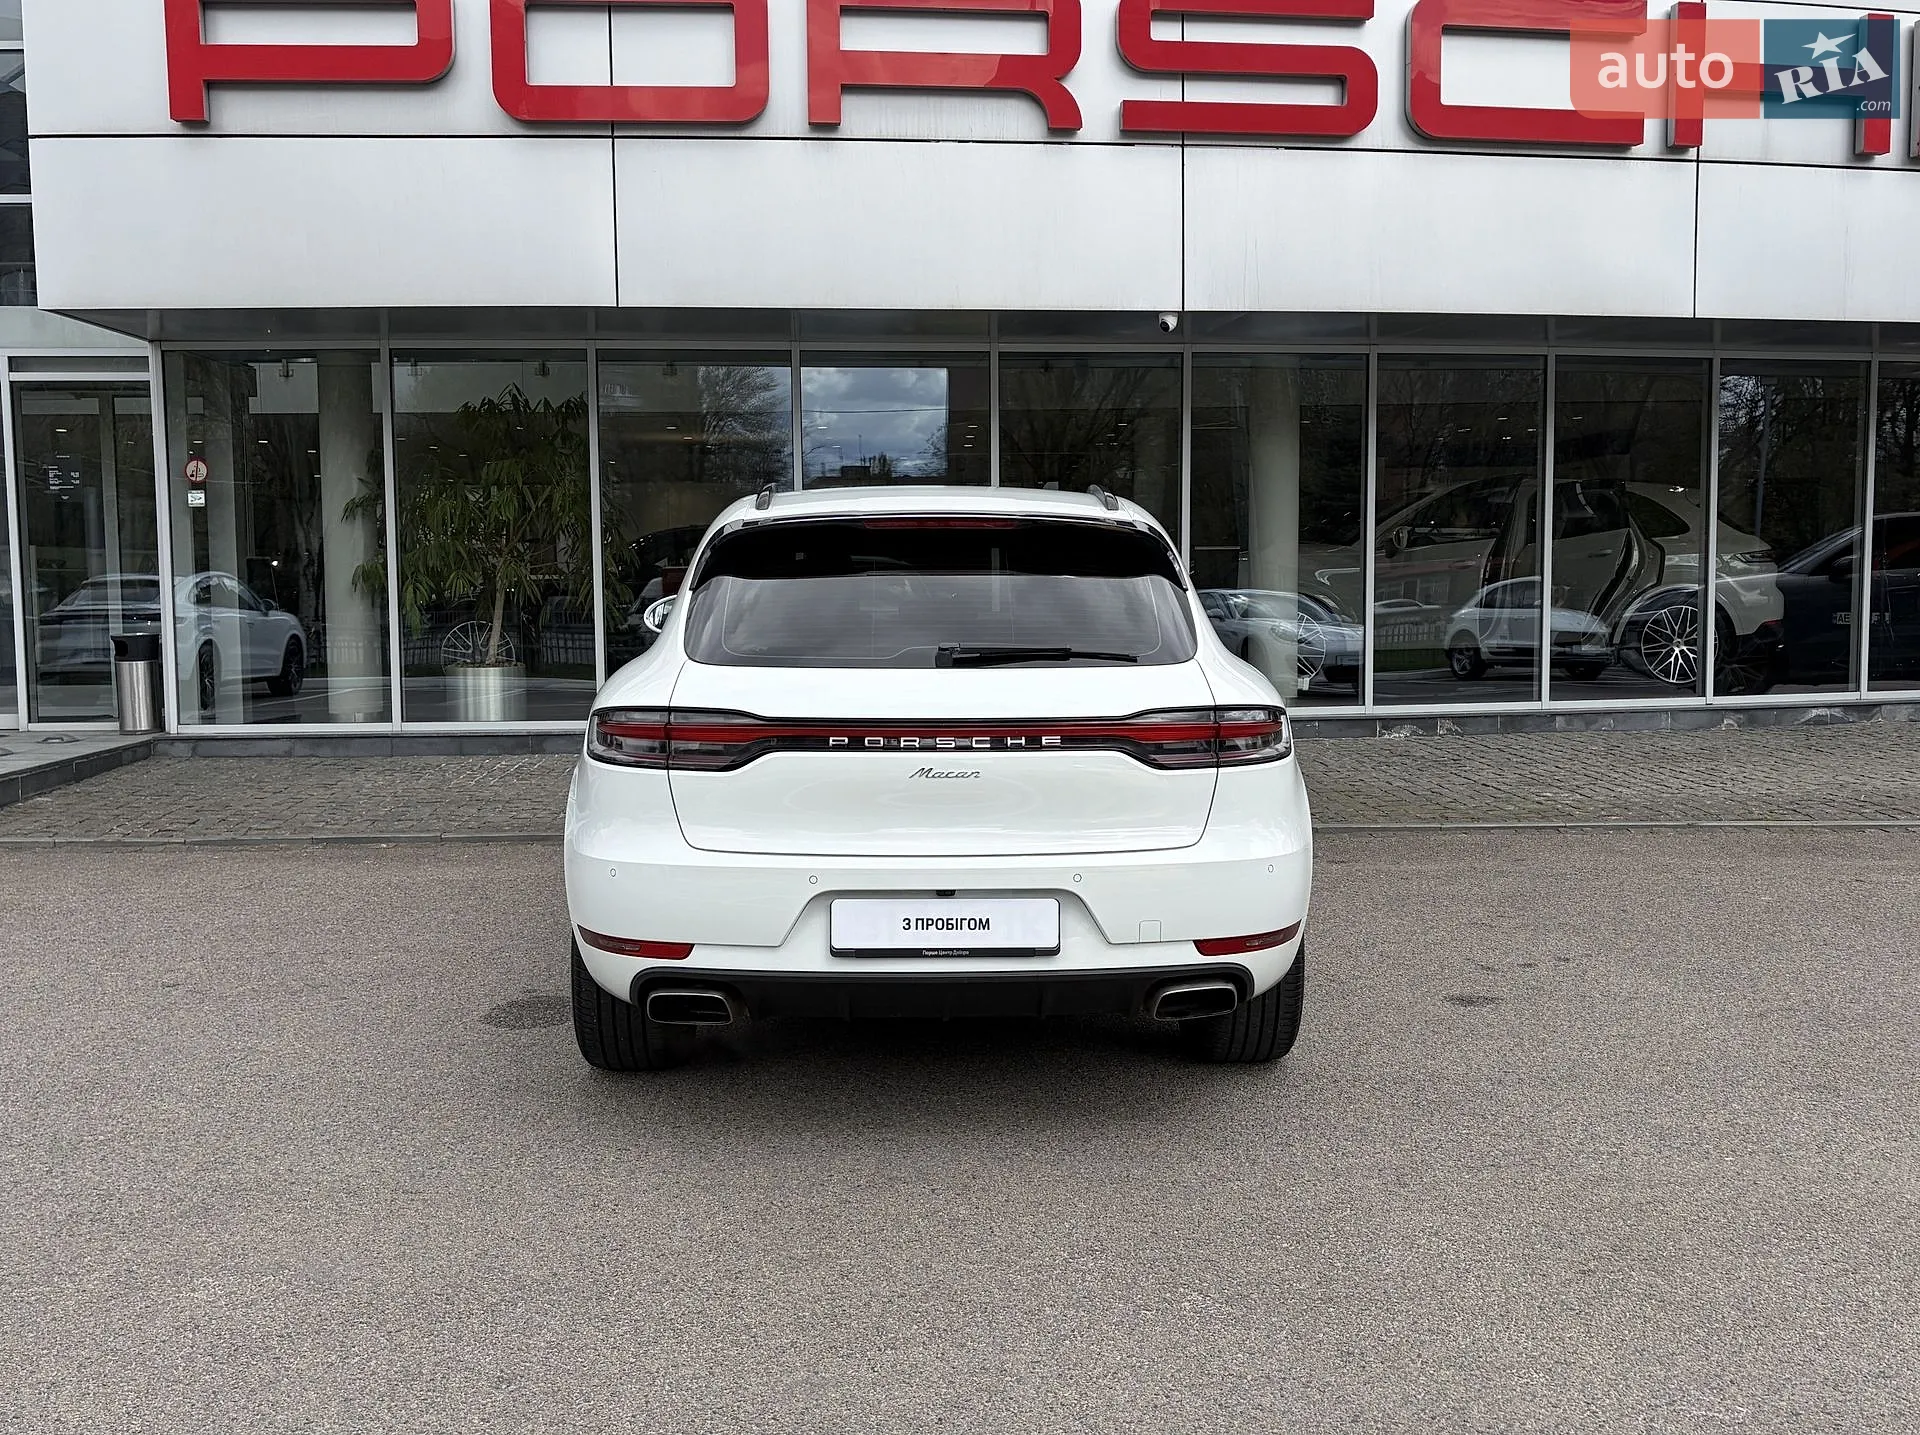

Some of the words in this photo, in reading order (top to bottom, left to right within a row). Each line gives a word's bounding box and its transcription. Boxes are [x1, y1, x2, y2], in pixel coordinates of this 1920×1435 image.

[165, 0, 1920, 158] PORSCH
[829, 736, 1061, 749] PORSCHE
[908, 767, 981, 779] Macan
[915, 917, 991, 931] ПРОБІГОМ
